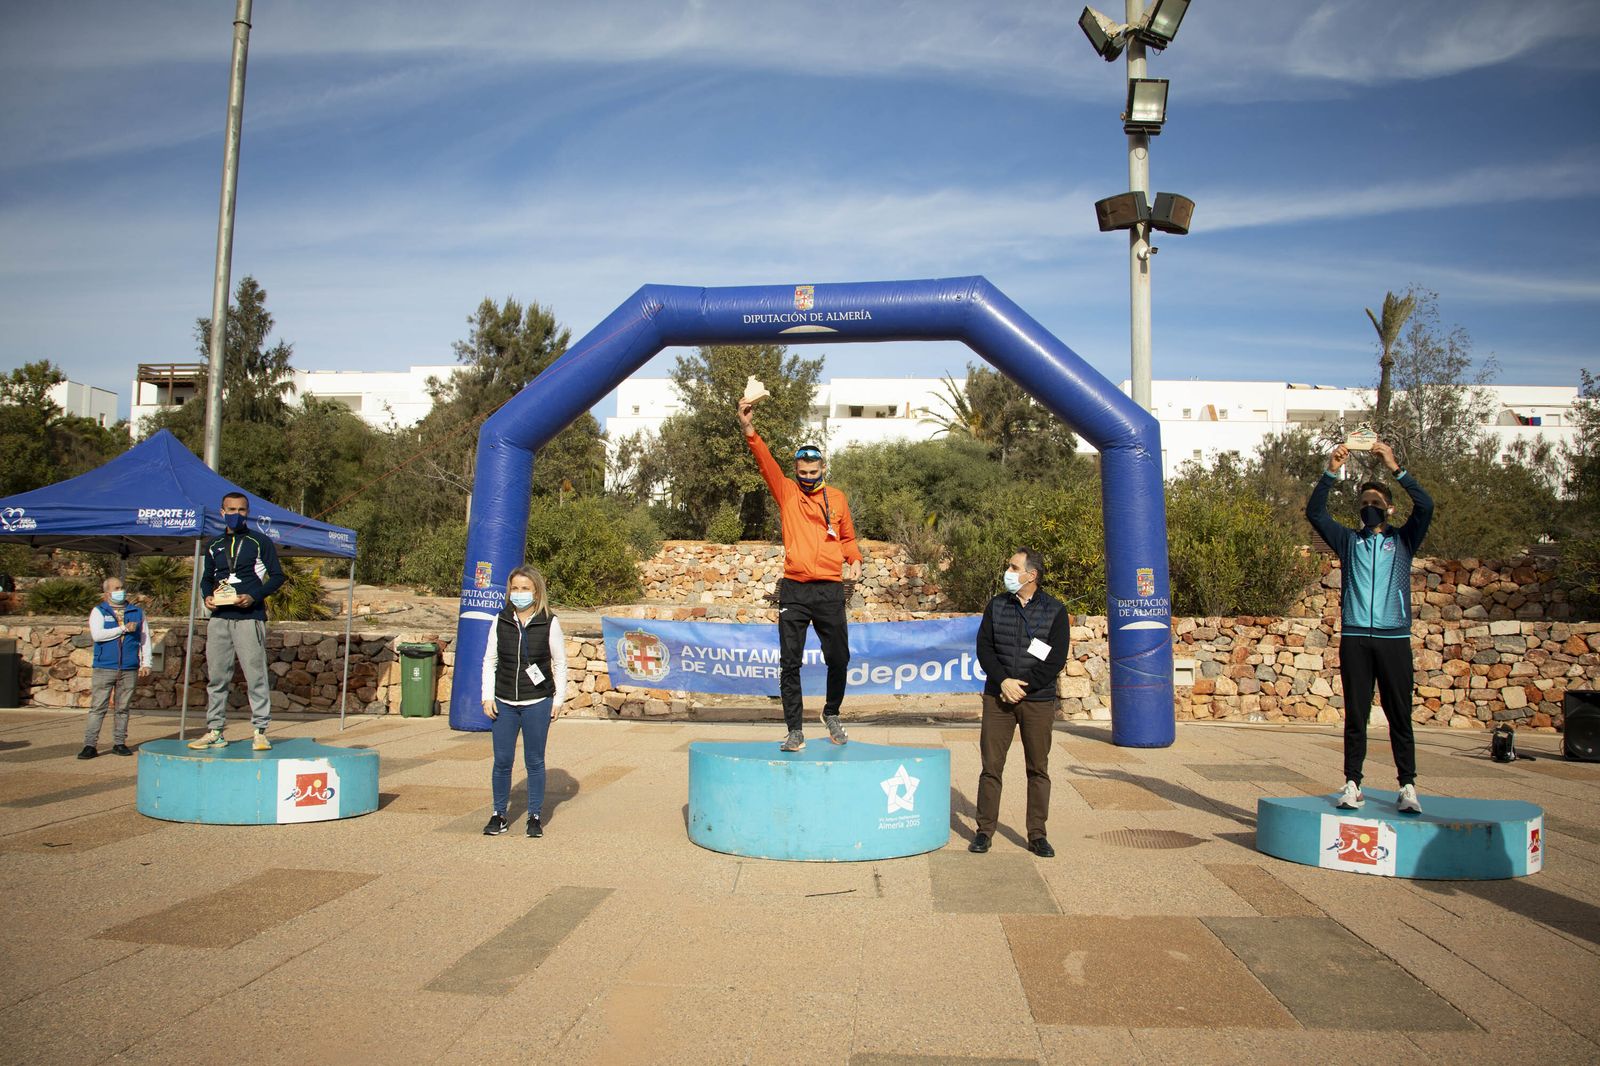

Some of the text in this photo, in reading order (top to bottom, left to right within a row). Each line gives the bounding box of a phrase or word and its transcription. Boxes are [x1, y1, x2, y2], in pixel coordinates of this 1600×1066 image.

[743, 309, 872, 324] DIPUTACIÓN DE ALMERÍA
[138, 509, 183, 518] DEPORTE
[467, 598, 504, 610] ALMERÍA
[1118, 597, 1169, 608] DIPUTACIÓN
[1119, 606, 1169, 617] DE ALMERÍA
[681, 645, 827, 665] AYUNTAMNT
[682, 659, 707, 674] DE
